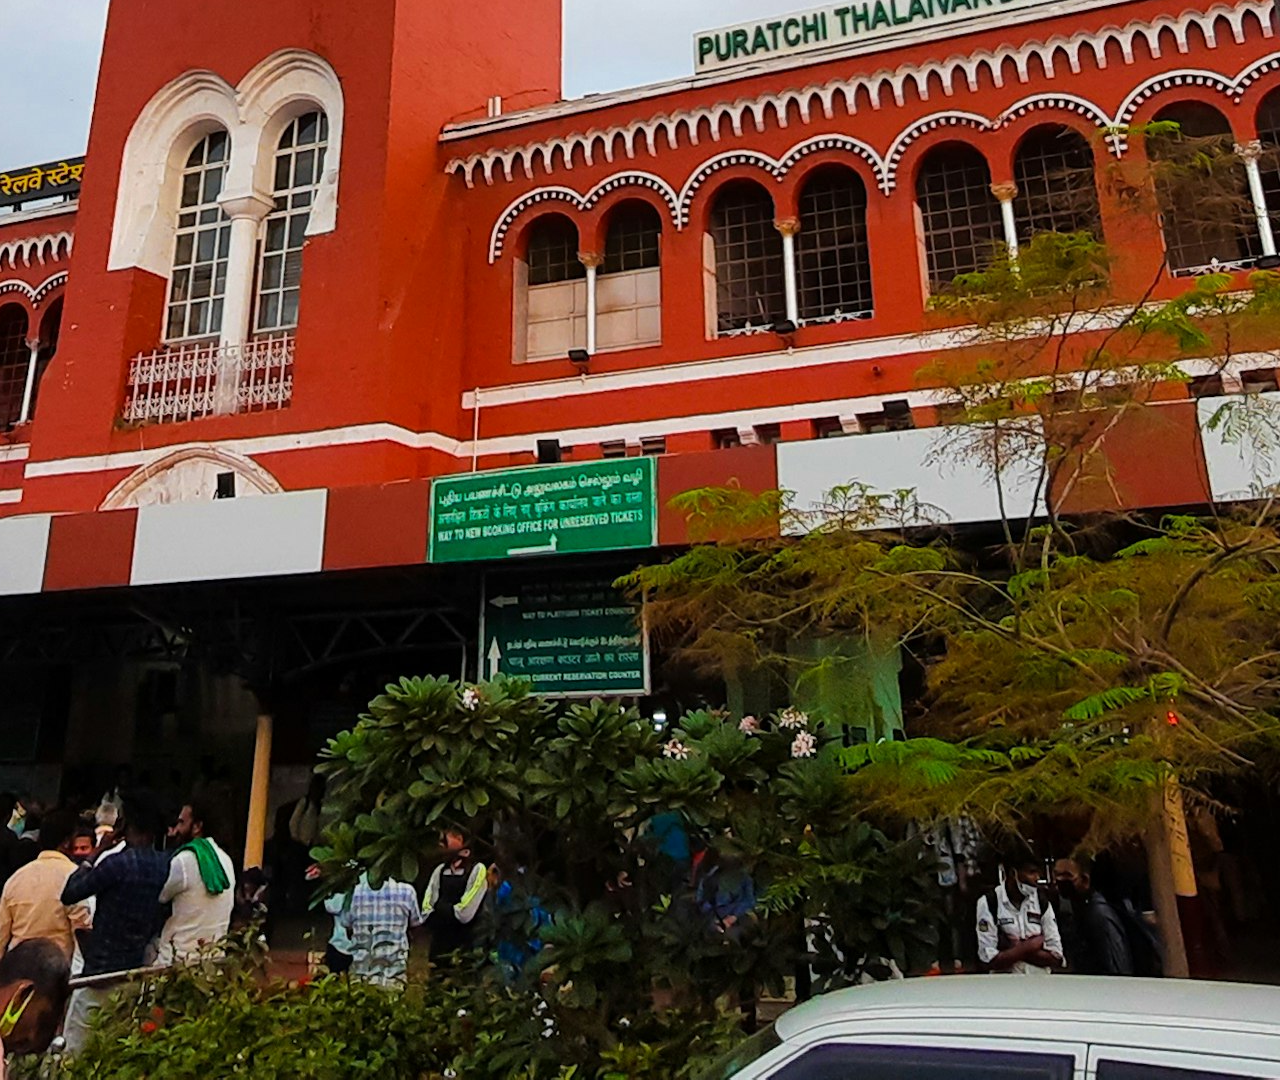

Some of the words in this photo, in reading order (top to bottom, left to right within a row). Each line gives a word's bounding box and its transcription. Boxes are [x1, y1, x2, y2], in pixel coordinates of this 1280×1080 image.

[698, 11, 828, 65] PURATCHI
[2, 168, 44, 196] रेलवे
[46, 162, 86, 187] स्टेश
[623, 467, 642, 486] வழி
[493, 503, 500, 518] के
[611, 493, 621, 505] का
[437, 530, 453, 542] WAY
[455, 529, 464, 540] TO
[465, 527, 480, 538] NEW
[483, 522, 514, 537] BOOKING
[517, 520, 541, 532] OFFICE
[544, 518, 558, 530] FOR
[560, 512, 608, 528] UNRESERVED
[610, 508, 642, 523] TICKETS
[581, 608, 602, 616] TICKET
[604, 653, 613, 662] का
[532, 673, 561, 681] CURRENT
[563, 671, 606, 680] RESERVATION
[608, 670, 640, 679] COUNTER
